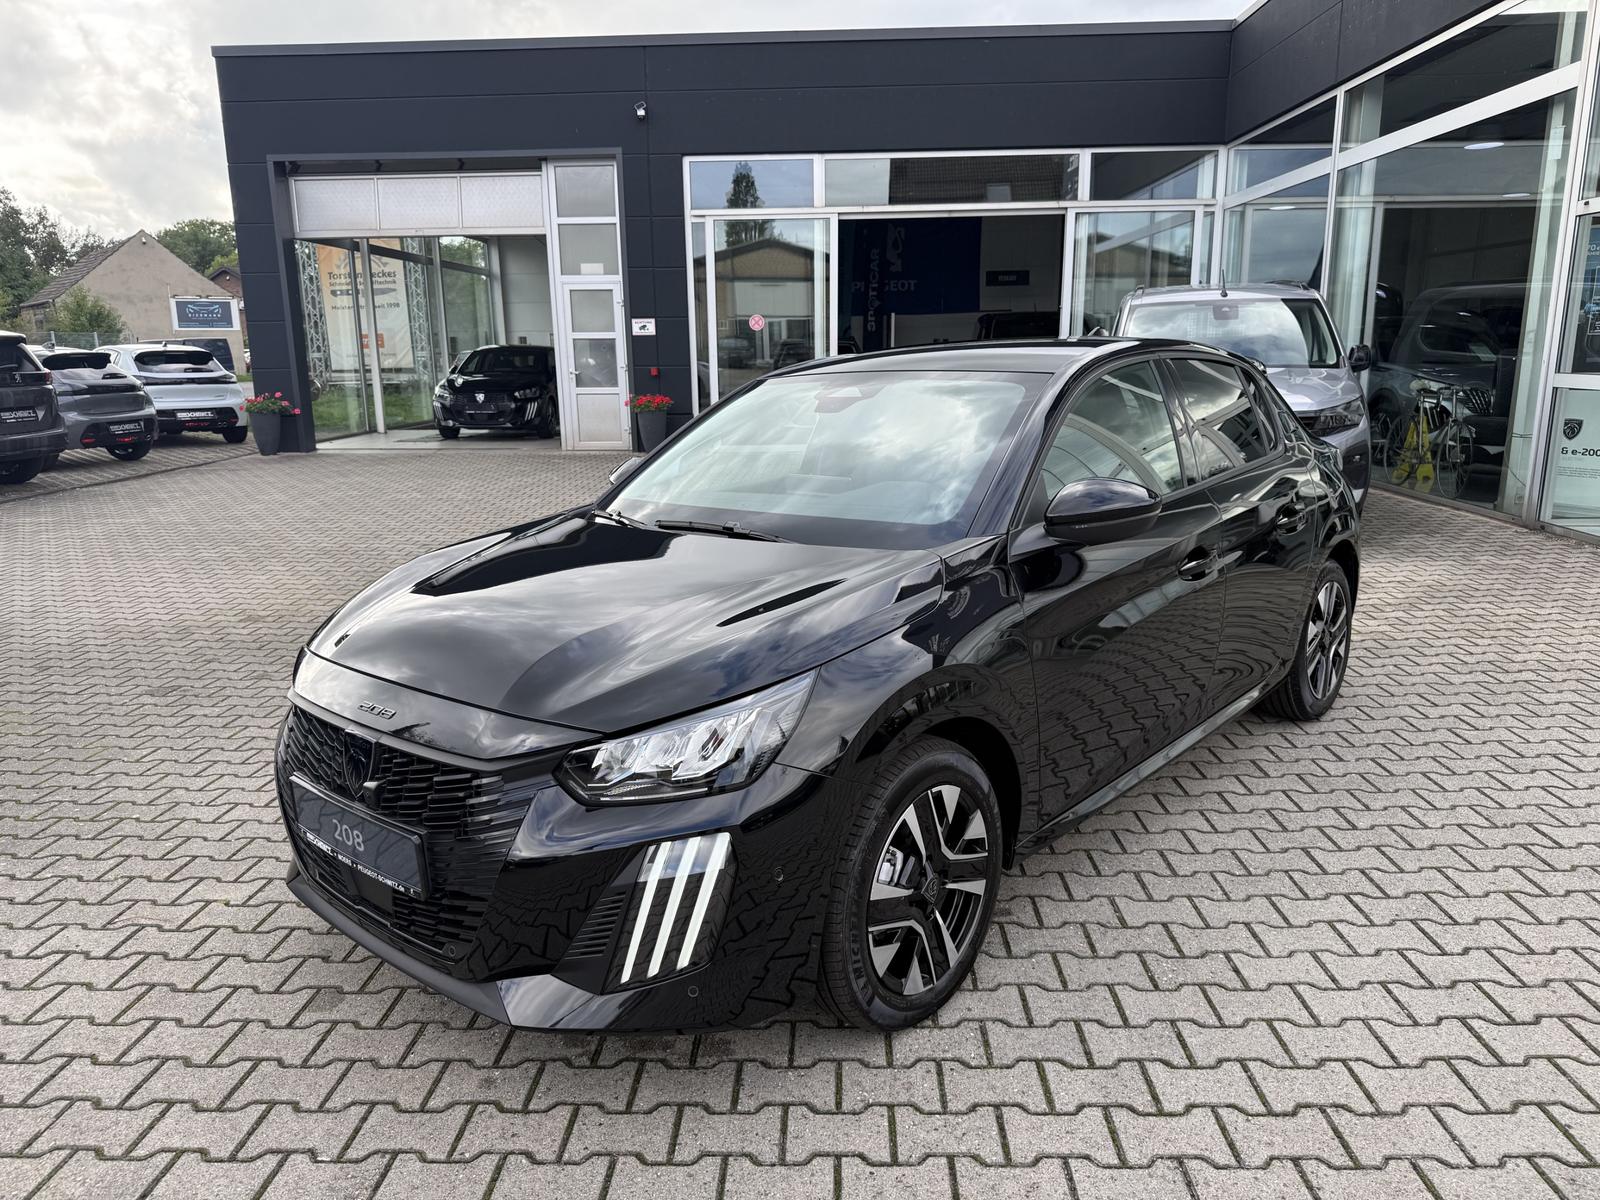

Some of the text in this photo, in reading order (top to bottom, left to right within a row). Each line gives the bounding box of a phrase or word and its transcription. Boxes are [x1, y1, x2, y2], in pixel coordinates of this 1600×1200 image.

[328, 269, 397, 280] Torstn eckes
[1561, 446, 1569, 455] &
[357, 701, 397, 720] 208
[332, 818, 365, 852] 208
